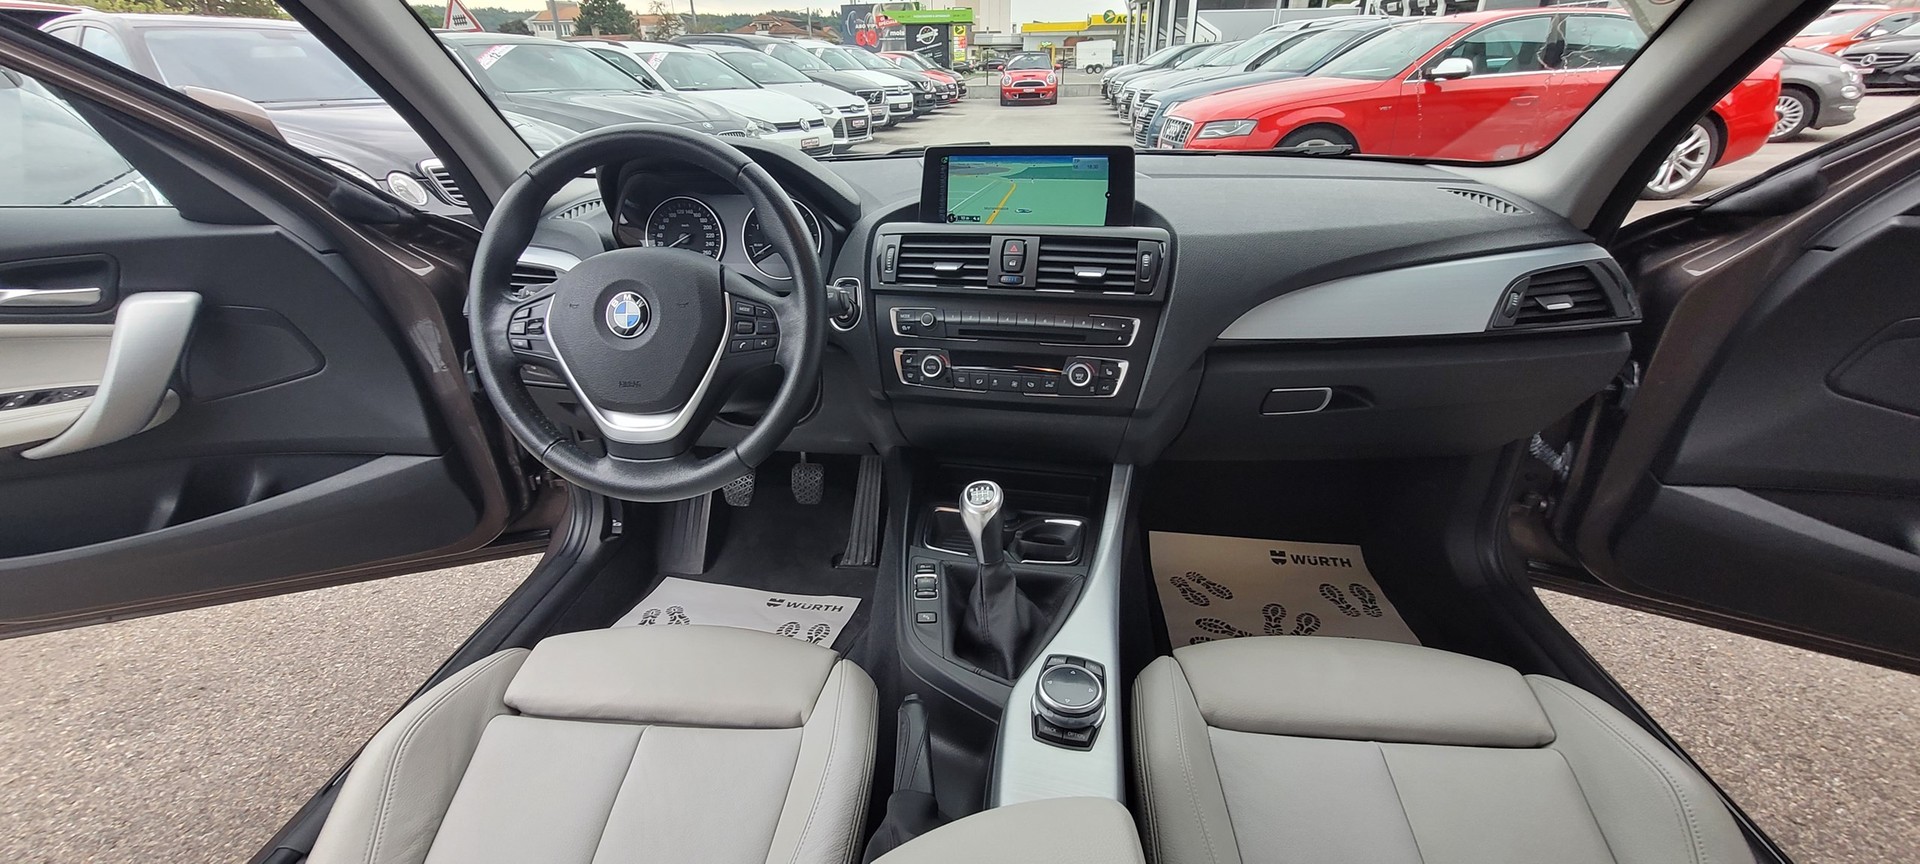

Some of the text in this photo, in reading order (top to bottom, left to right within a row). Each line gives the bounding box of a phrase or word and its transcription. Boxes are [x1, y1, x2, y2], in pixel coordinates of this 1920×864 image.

[610, 294, 645, 308] BMW
[1290, 554, 1353, 568] WÜRTH
[787, 602, 843, 612] WÜRTH
[1067, 731, 1086, 739] OPTION
